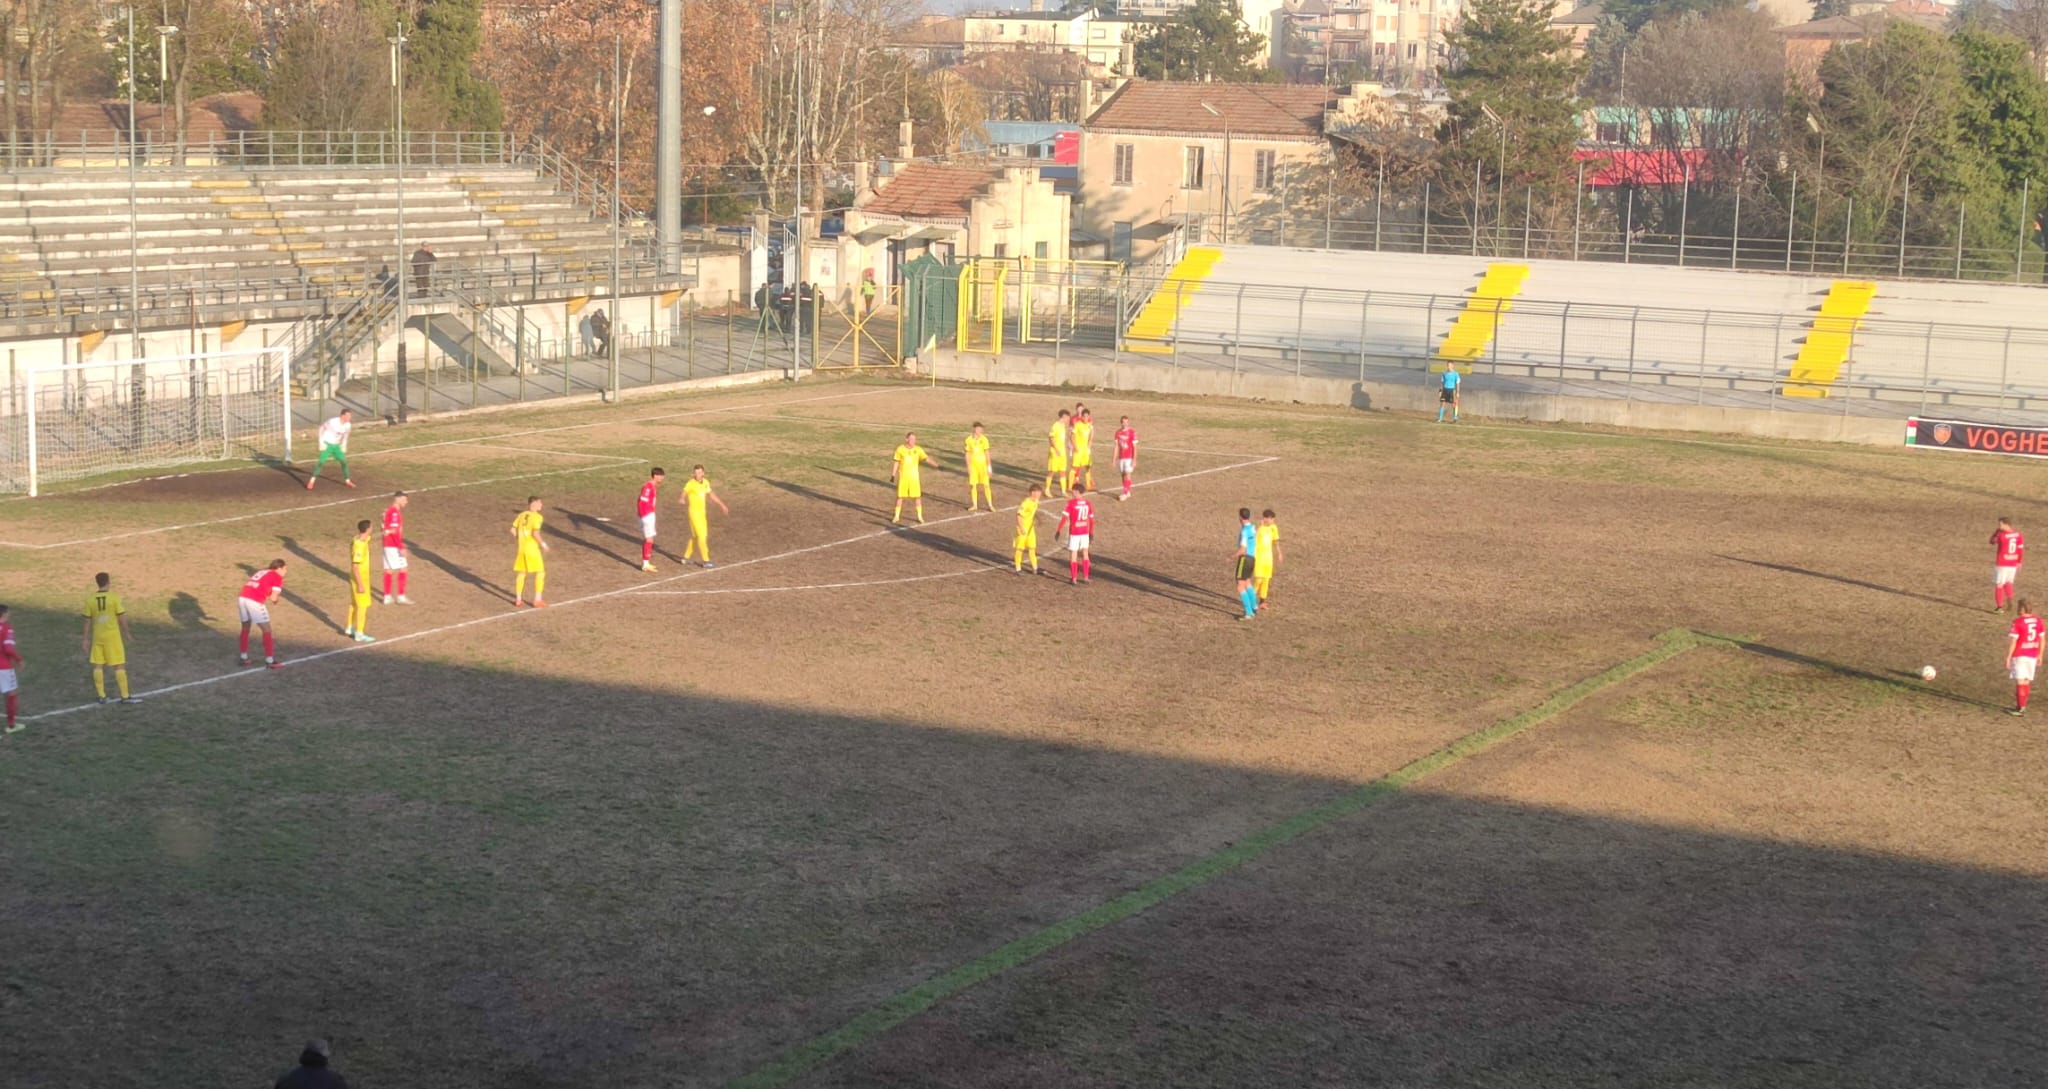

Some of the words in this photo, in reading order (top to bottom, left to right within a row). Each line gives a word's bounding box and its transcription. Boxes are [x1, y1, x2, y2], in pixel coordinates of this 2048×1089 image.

[1967, 427, 2048, 453] VOGHE
[1075, 505, 1089, 521] 70
[2008, 538, 2017, 554] 6
[96, 596, 106, 611] 11
[2027, 623, 2037, 641] 5
